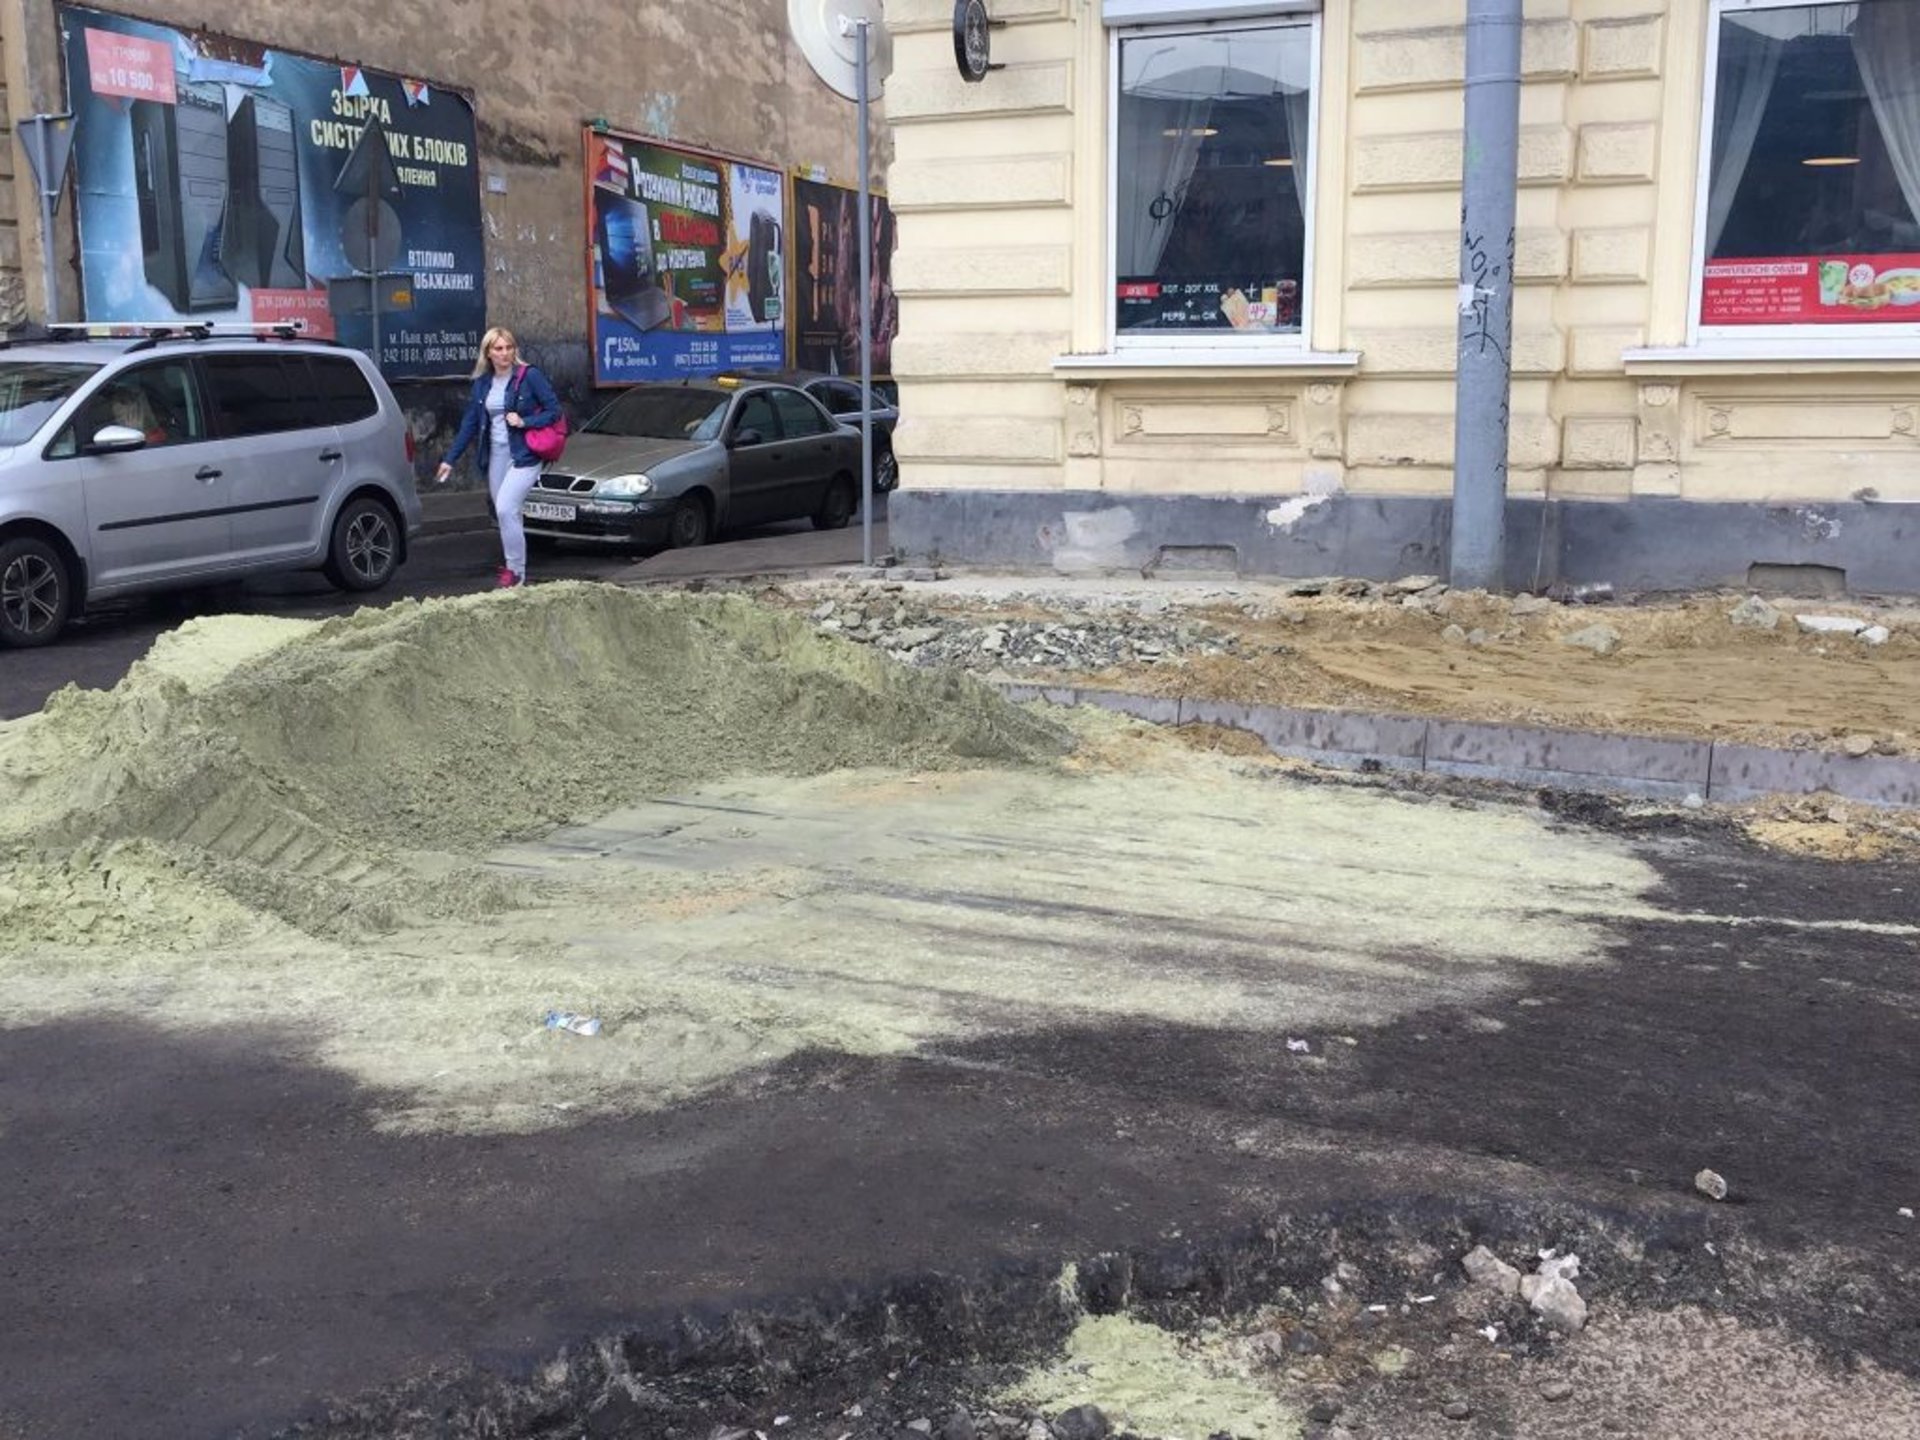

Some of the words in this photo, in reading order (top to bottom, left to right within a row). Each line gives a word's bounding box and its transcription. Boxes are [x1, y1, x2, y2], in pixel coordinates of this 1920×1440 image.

[109, 67, 127, 88] 10
[128, 70, 155, 91] 500
[310, 119, 410, 159] СИСТЕИХ
[413, 135, 468, 167] БЛОКІВ
[408, 250, 455, 269] ВТІЛИМО
[412, 273, 475, 290] ОБАЖАННЯ!
[1162, 312, 1186, 321] PEPSI
